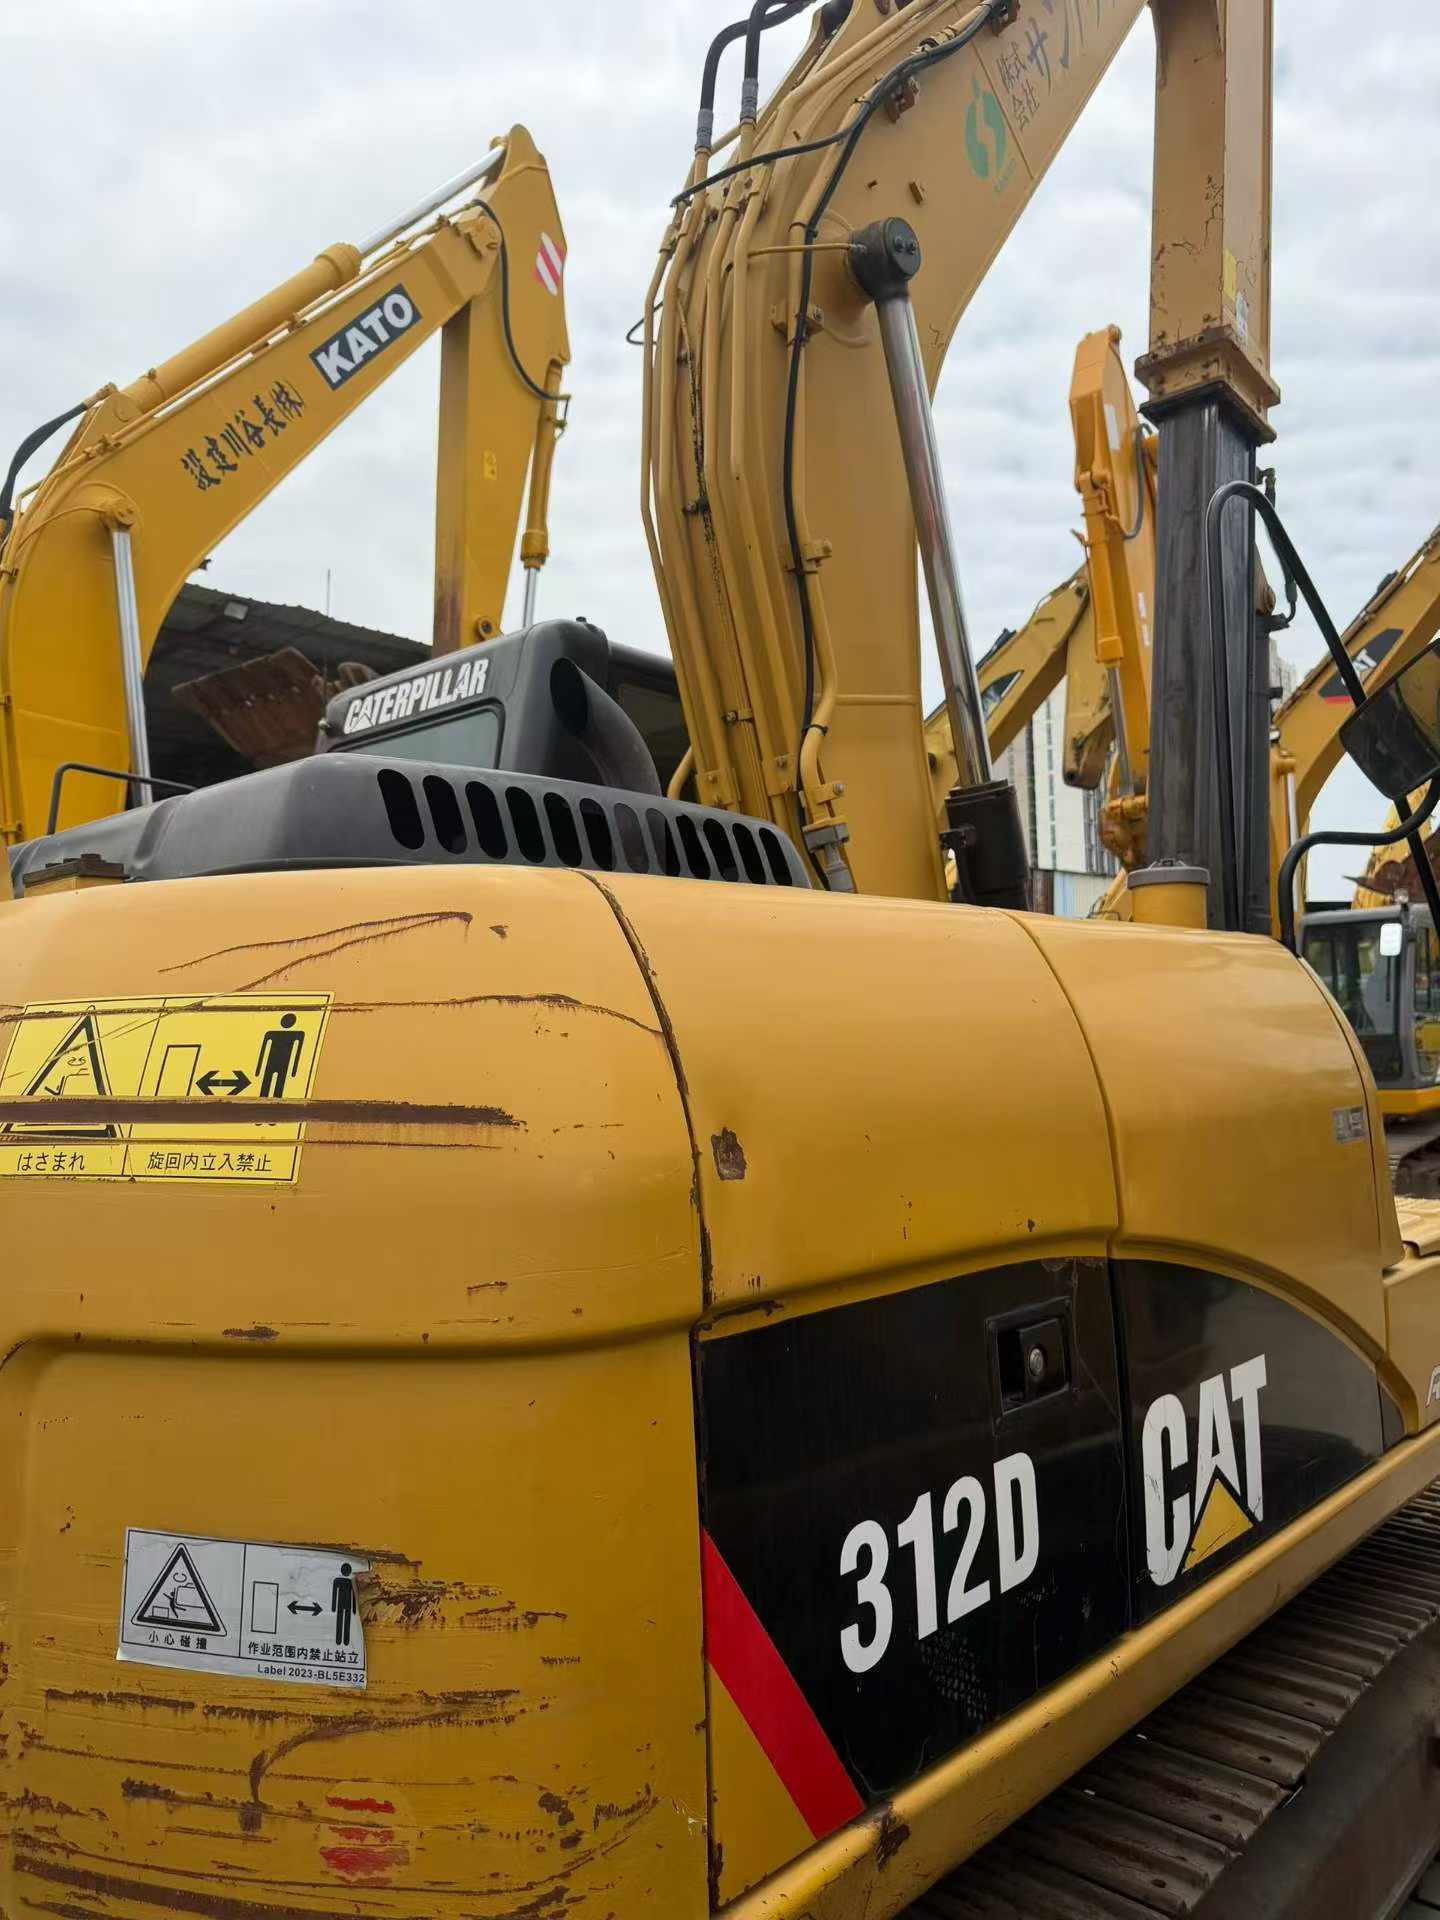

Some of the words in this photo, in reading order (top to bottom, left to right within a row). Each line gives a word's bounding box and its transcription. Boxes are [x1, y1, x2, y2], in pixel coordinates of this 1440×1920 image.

[316, 293, 413, 384] KATO
[343, 658, 490, 735] CATERPILLAR
[17, 1153, 85, 1171] はさまれ
[147, 1152, 272, 1172] 旋回内立入禁止
[1142, 1353, 1268, 1586] CAT
[839, 1451, 1040, 1674] 312D
[148, 1630, 208, 1650] 小心碰撞
[248, 1641, 360, 1665] 作业范围内禁止站立
[257, 1664, 286, 1676] Label
[288, 1667, 365, 1683] 2023-BL5E332
